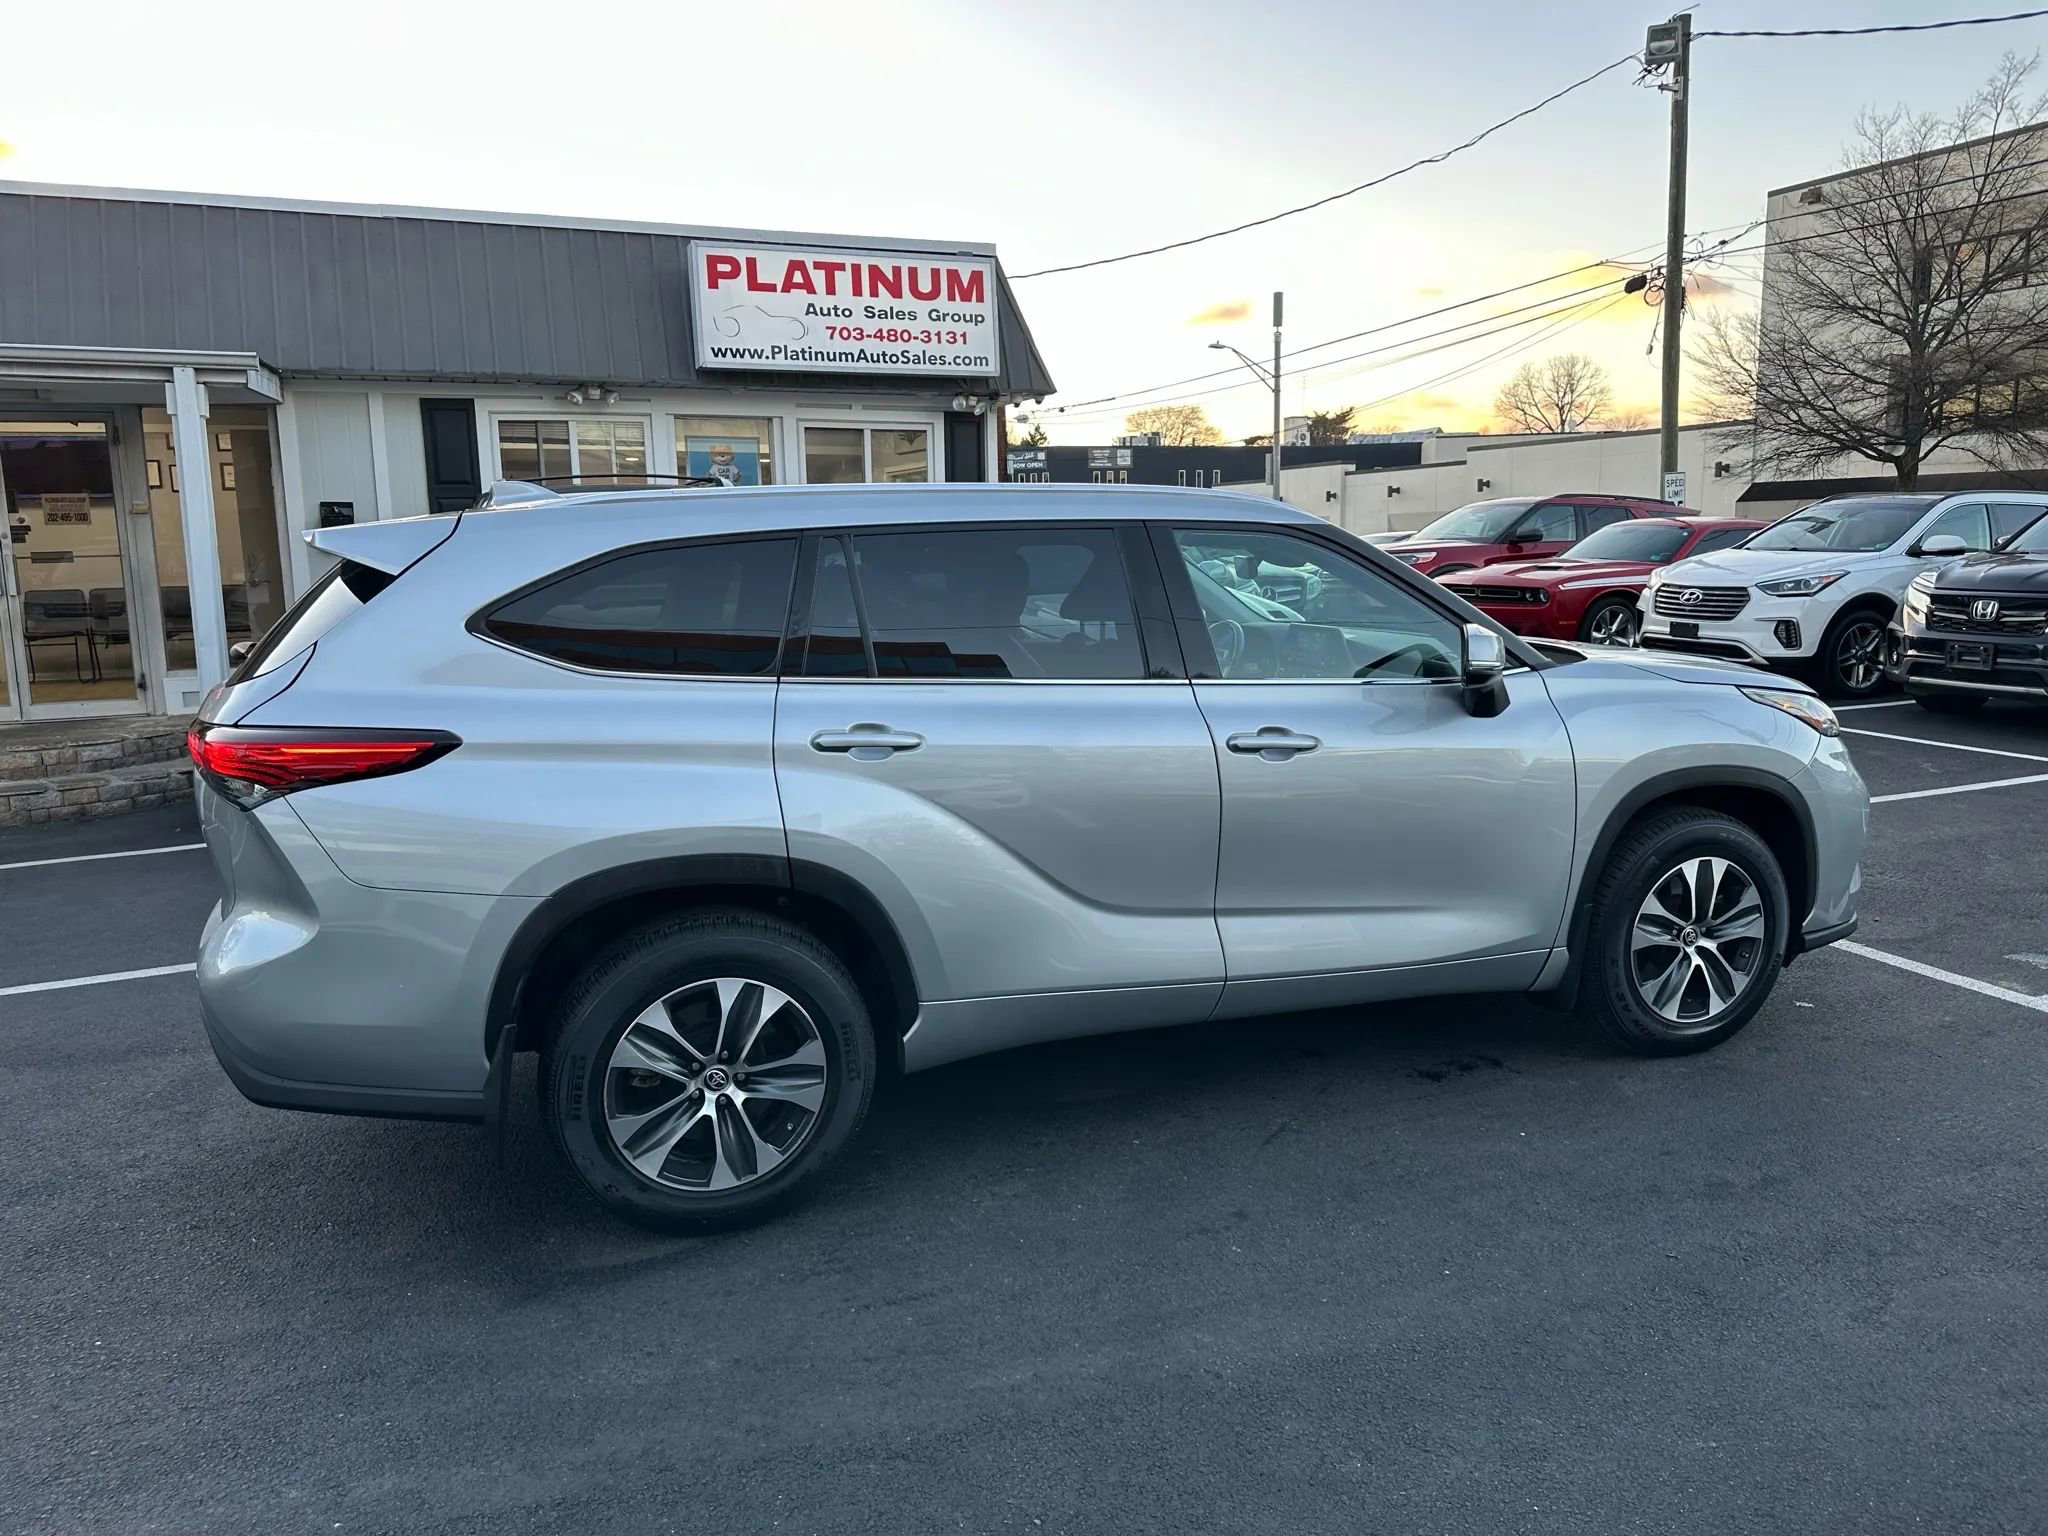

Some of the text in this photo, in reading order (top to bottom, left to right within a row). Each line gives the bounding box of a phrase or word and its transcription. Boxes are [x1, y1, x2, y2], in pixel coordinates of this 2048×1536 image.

[705, 254, 985, 303] PLATINUM
[804, 302, 986, 326] Auto Sales Group
[825, 325, 968, 345] 703-480-3131
[710, 345, 989, 367] www.PlatinumAutoSales.com
[1668, 490, 1683, 499] LIMIT
